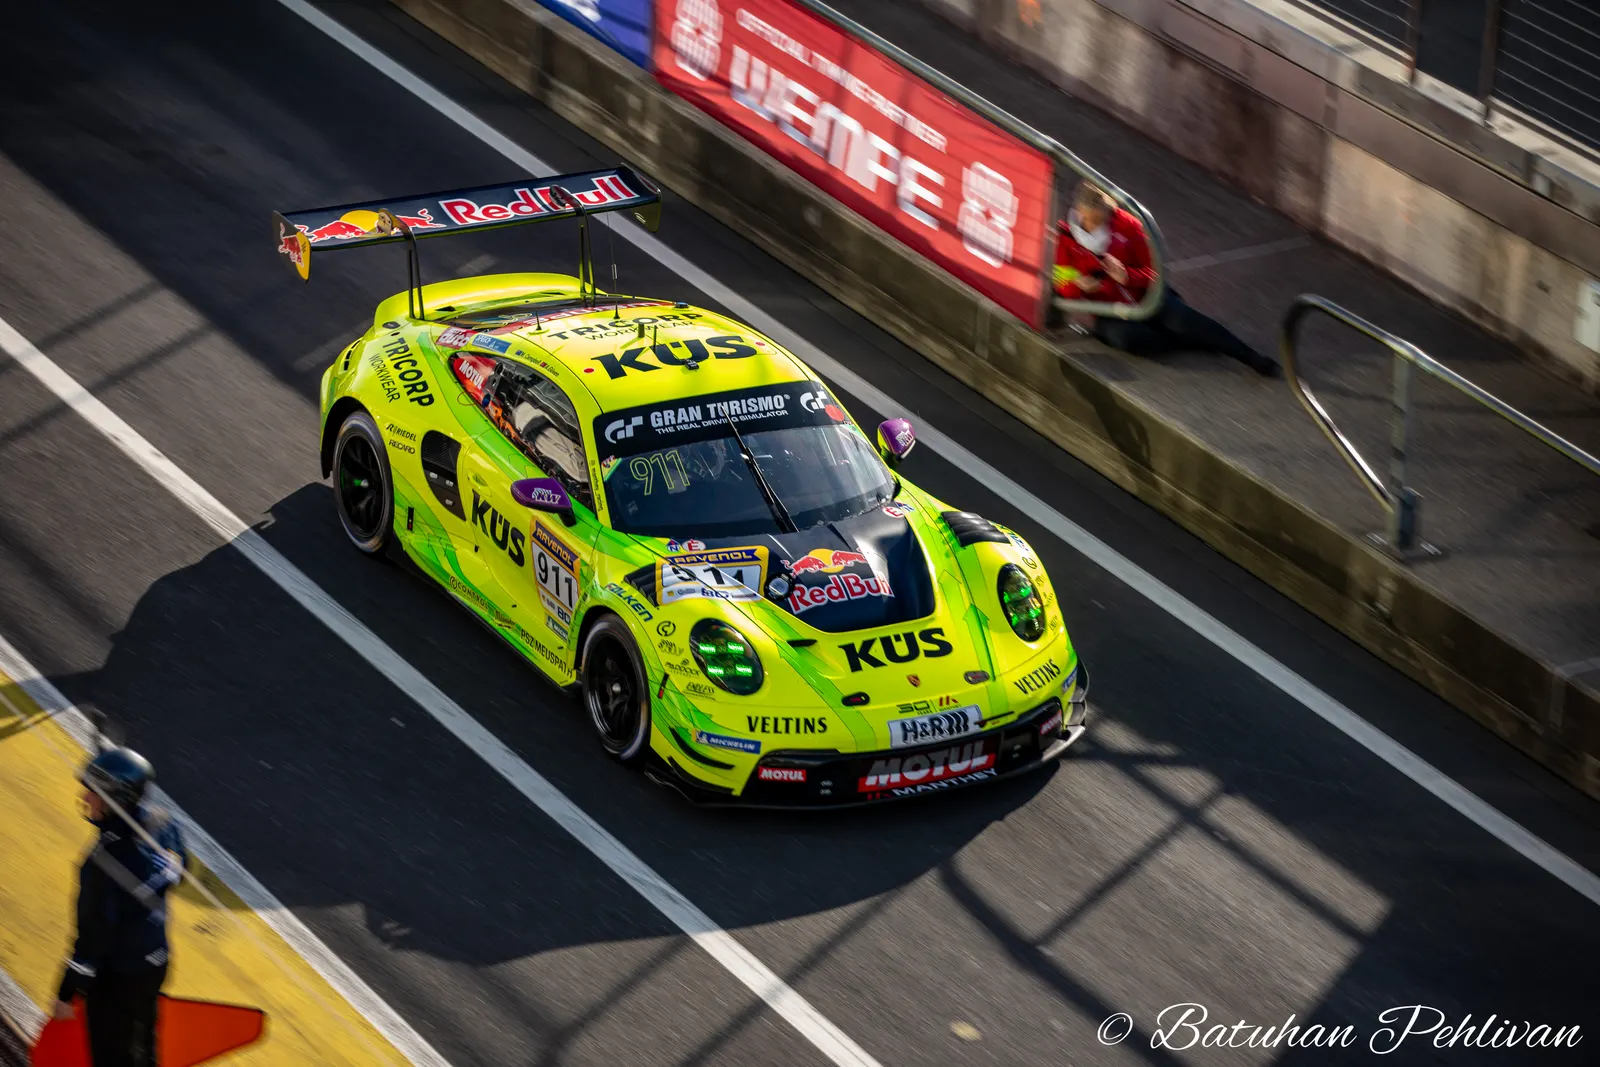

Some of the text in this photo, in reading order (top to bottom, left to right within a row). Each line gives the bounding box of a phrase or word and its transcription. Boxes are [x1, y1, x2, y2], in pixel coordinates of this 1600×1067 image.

[439, 188, 548, 225] Red
[547, 313, 703, 340] TRICORP
[585, 320, 695, 341] WORKWEAR
[382, 337, 435, 407] TRICORP
[459, 360, 485, 389] MOTUL
[591, 336, 757, 380] KÜS
[368, 353, 400, 403] WORKWEAR
[650, 405, 702, 428] GRAN
[655, 424, 676, 435] THE
[677, 421, 701, 431] REAL
[739, 409, 789, 422] SIMULATOR
[388, 439, 416, 454] RECARO
[629, 450, 690, 496] 911
[533, 489, 561, 504] KW
[471, 489, 526, 567] KÜS
[536, 527, 572, 566] RAVENOL
[672, 551, 753, 564] RAVENOL
[538, 552, 573, 609] 911
[788, 572, 894, 614] Red Bull
[838, 628, 953, 672] KÜS
[1013, 658, 1061, 695] VELTINS
[747, 715, 828, 734] VELTINS
[710, 737, 755, 750] MICHELIN
[761, 768, 804, 780] MOTUL
[865, 740, 989, 787] MOTUL
[892, 768, 998, 796] MANTHEY
